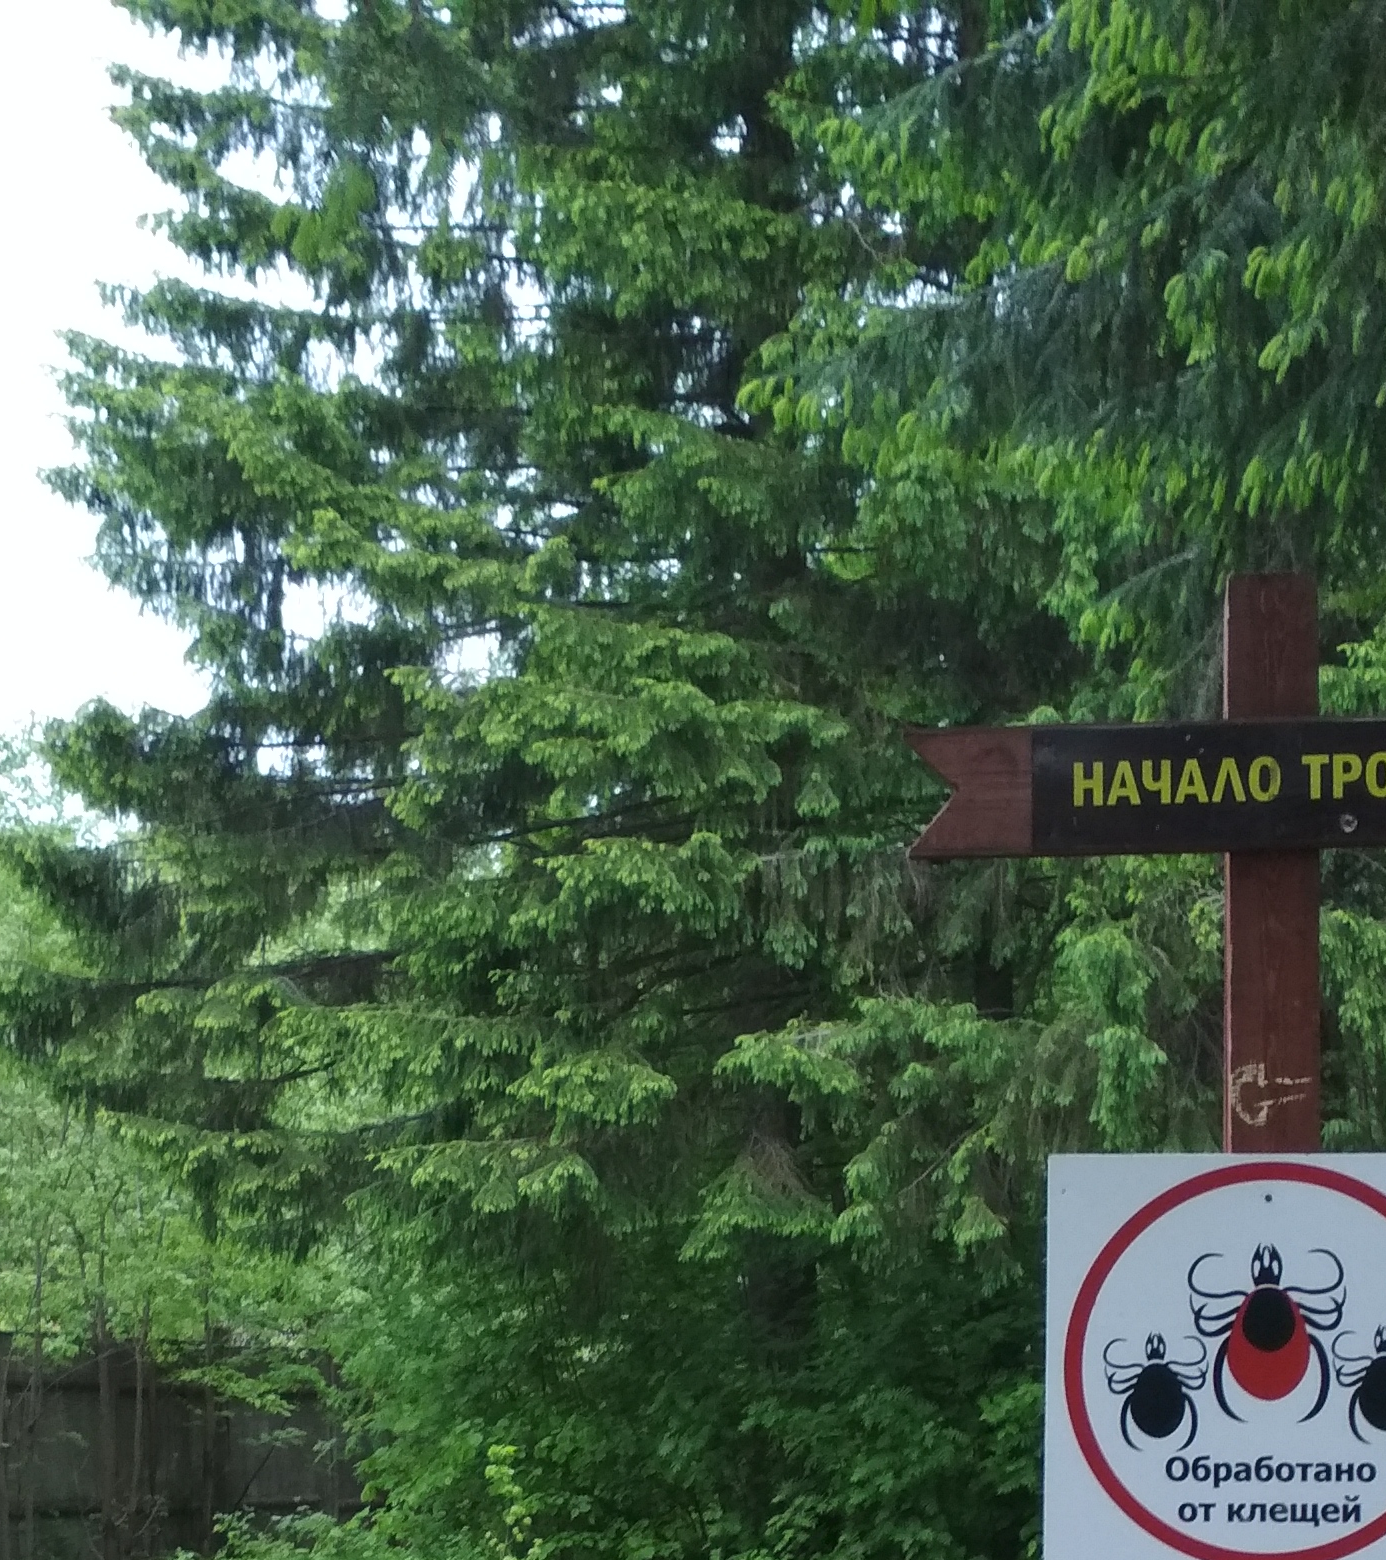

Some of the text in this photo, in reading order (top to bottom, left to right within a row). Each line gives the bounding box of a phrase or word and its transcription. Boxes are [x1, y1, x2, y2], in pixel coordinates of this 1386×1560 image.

[1073, 755, 1282, 807] НАЧАЛО
[1165, 1455, 1377, 1488] Обработано
[1177, 1494, 1361, 1527] от клещей
